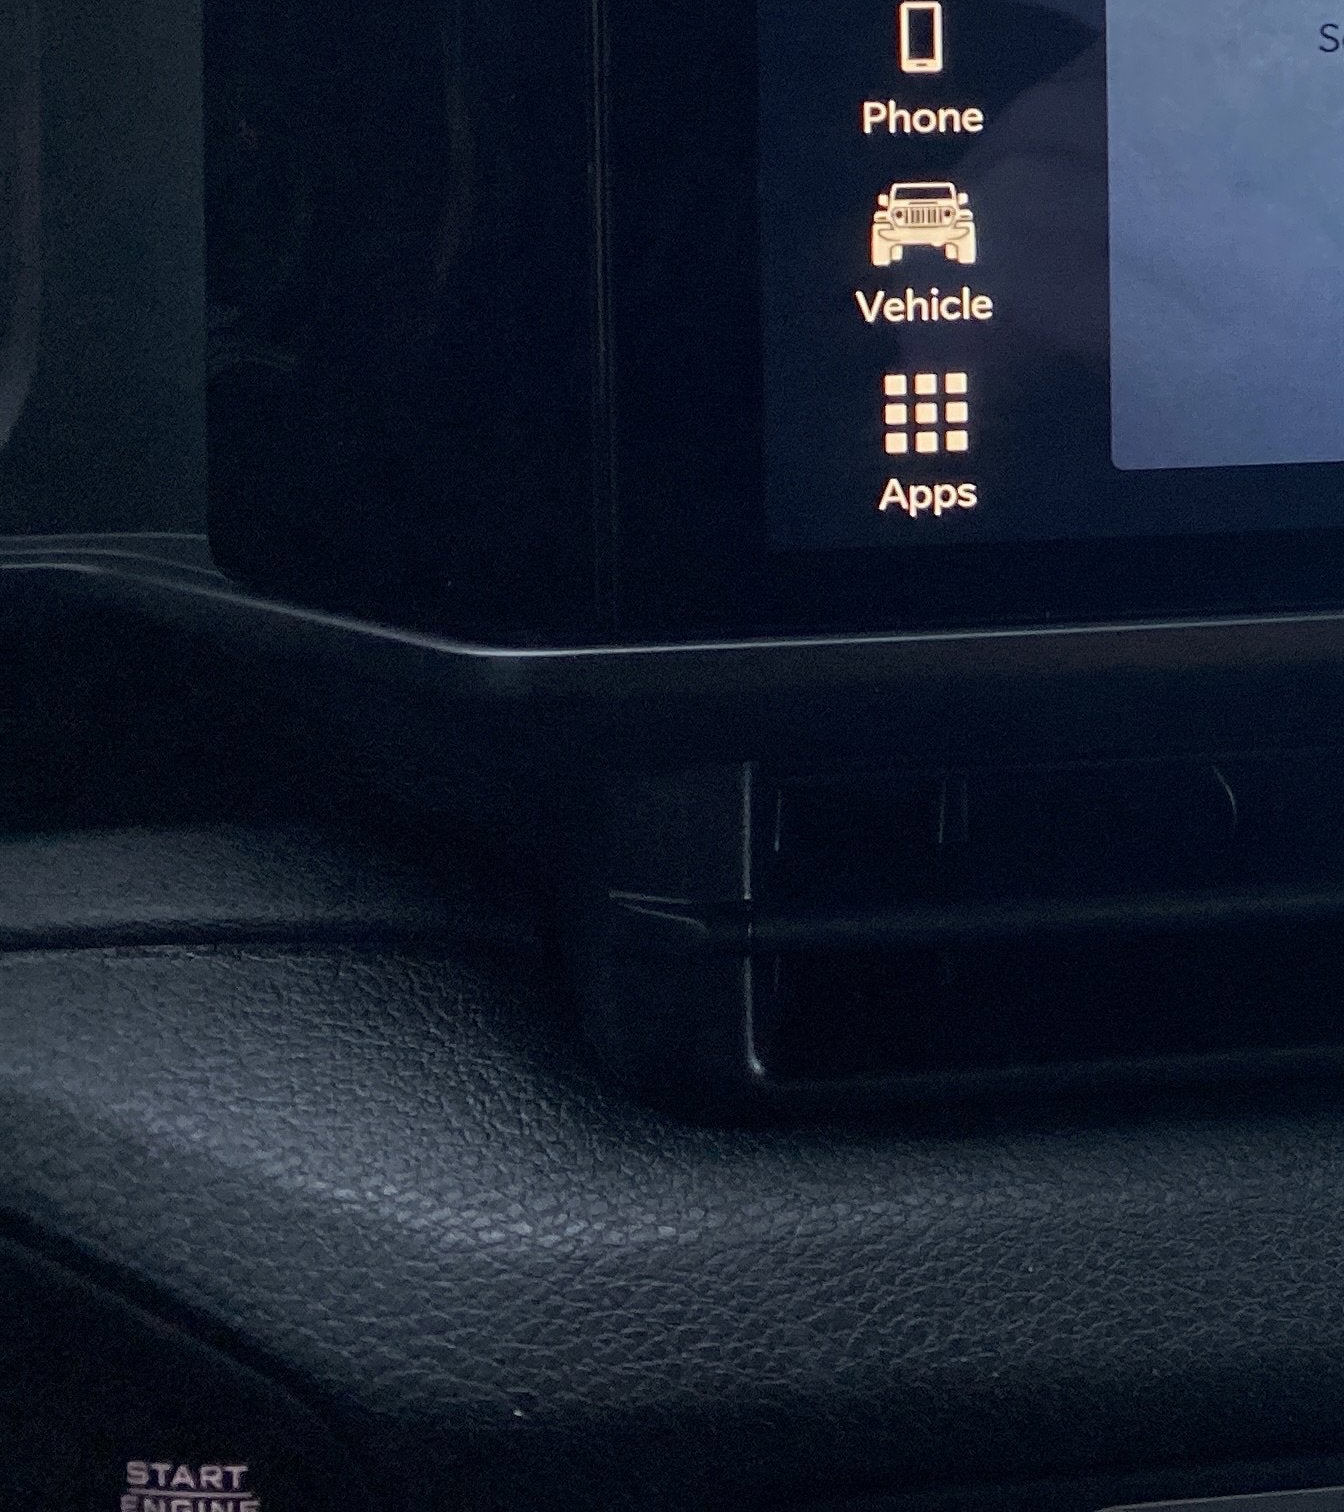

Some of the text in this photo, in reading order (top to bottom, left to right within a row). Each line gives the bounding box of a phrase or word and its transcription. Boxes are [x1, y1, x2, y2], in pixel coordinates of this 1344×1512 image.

[862, 99, 985, 134] Phone
[854, 287, 994, 323] Vehicle
[878, 477, 978, 517] Apps
[126, 1460, 250, 1489] START
